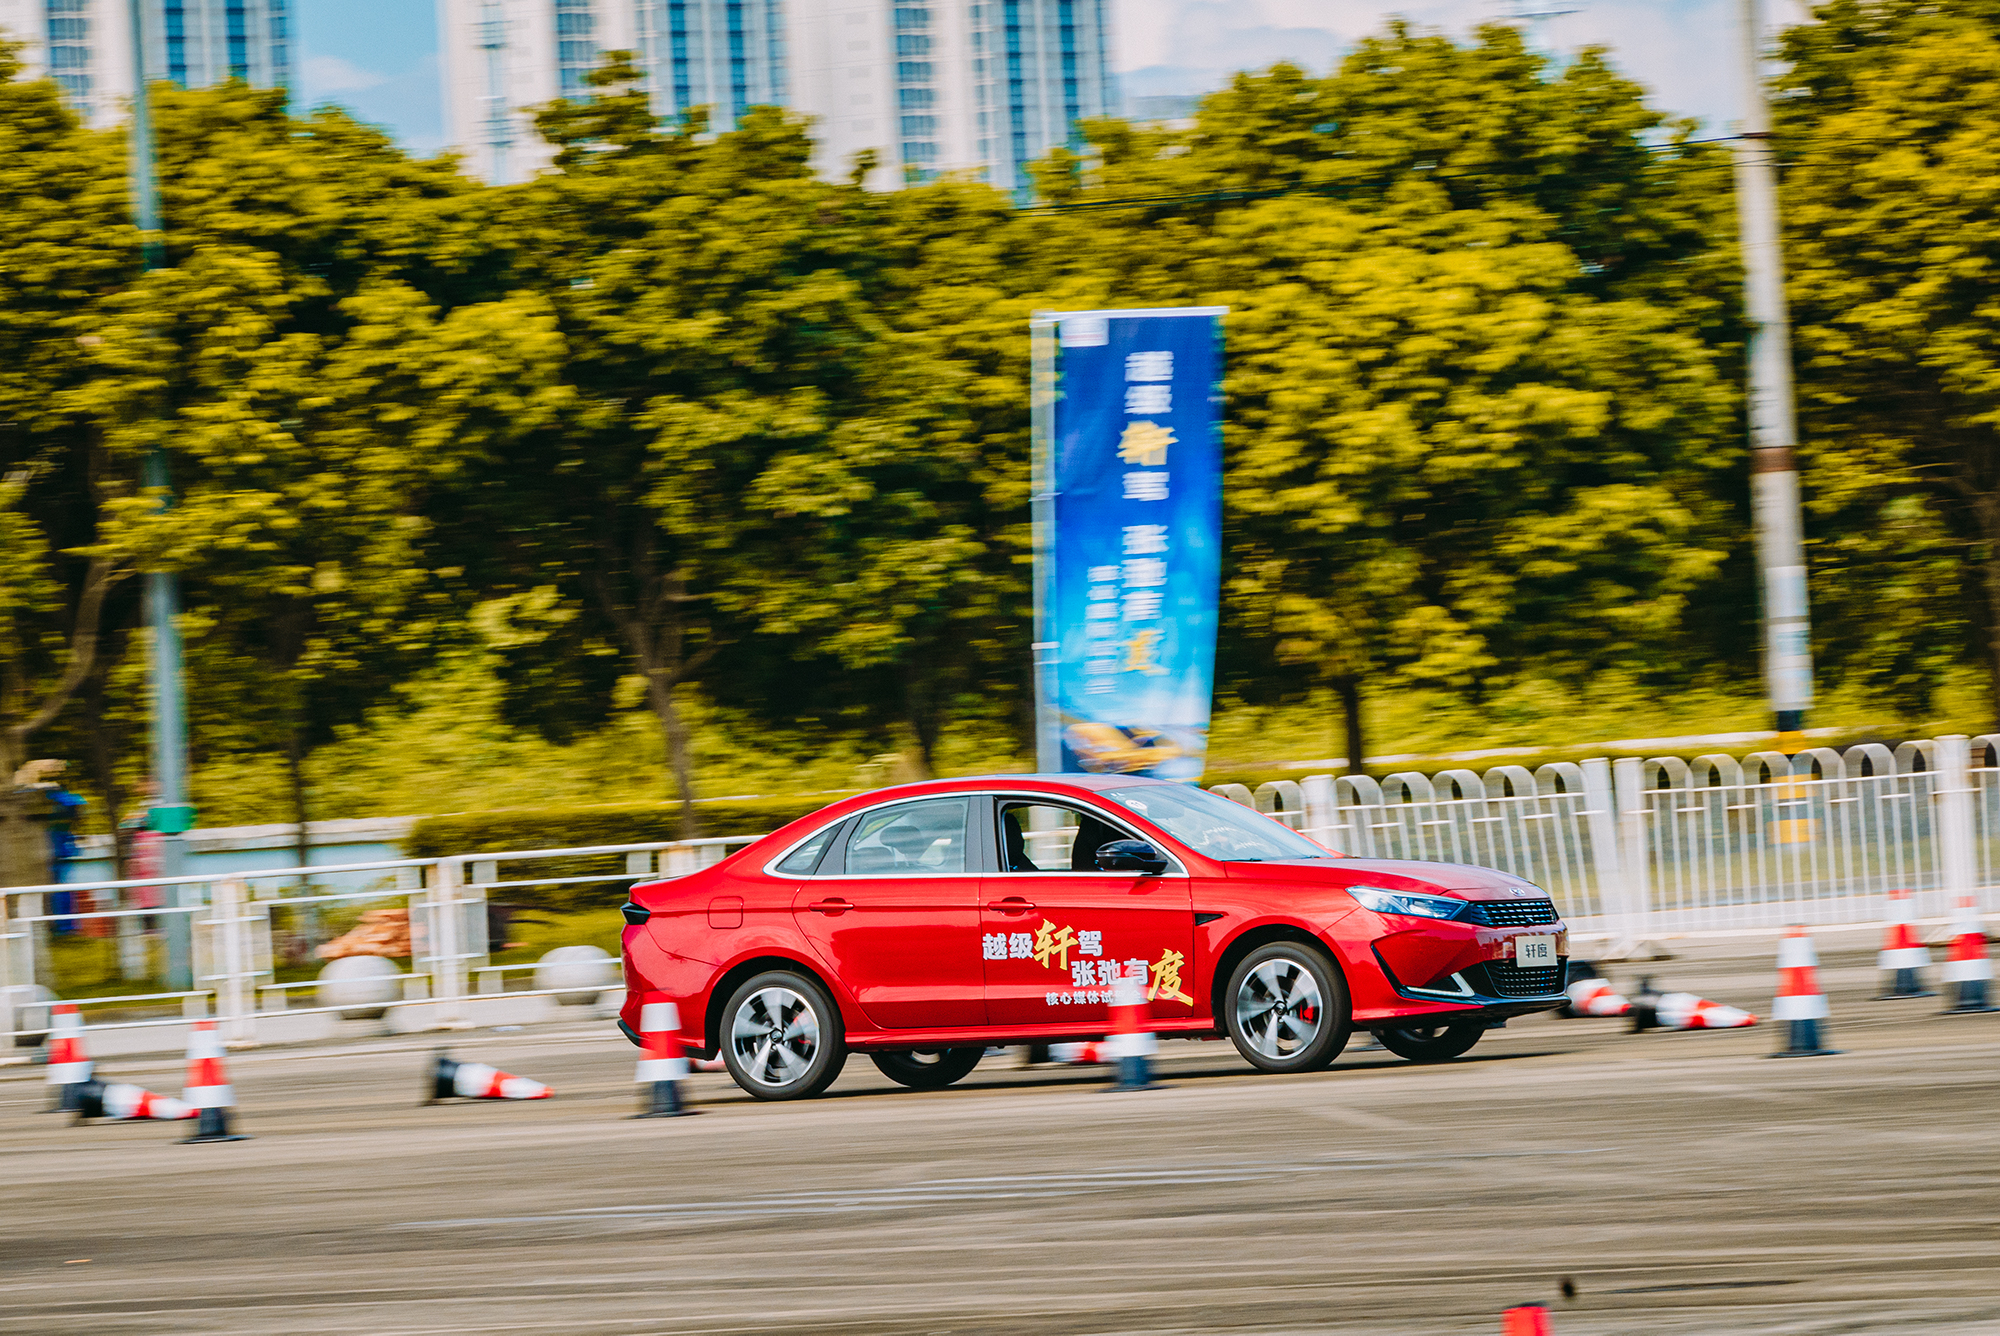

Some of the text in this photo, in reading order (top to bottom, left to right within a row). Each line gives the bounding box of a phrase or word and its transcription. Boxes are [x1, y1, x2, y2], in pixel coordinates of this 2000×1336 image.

[982, 918, 1102, 971] 越级轩驾
[1525, 943, 1548, 958] 轩度
[1071, 948, 1194, 1007] 张弛有度
